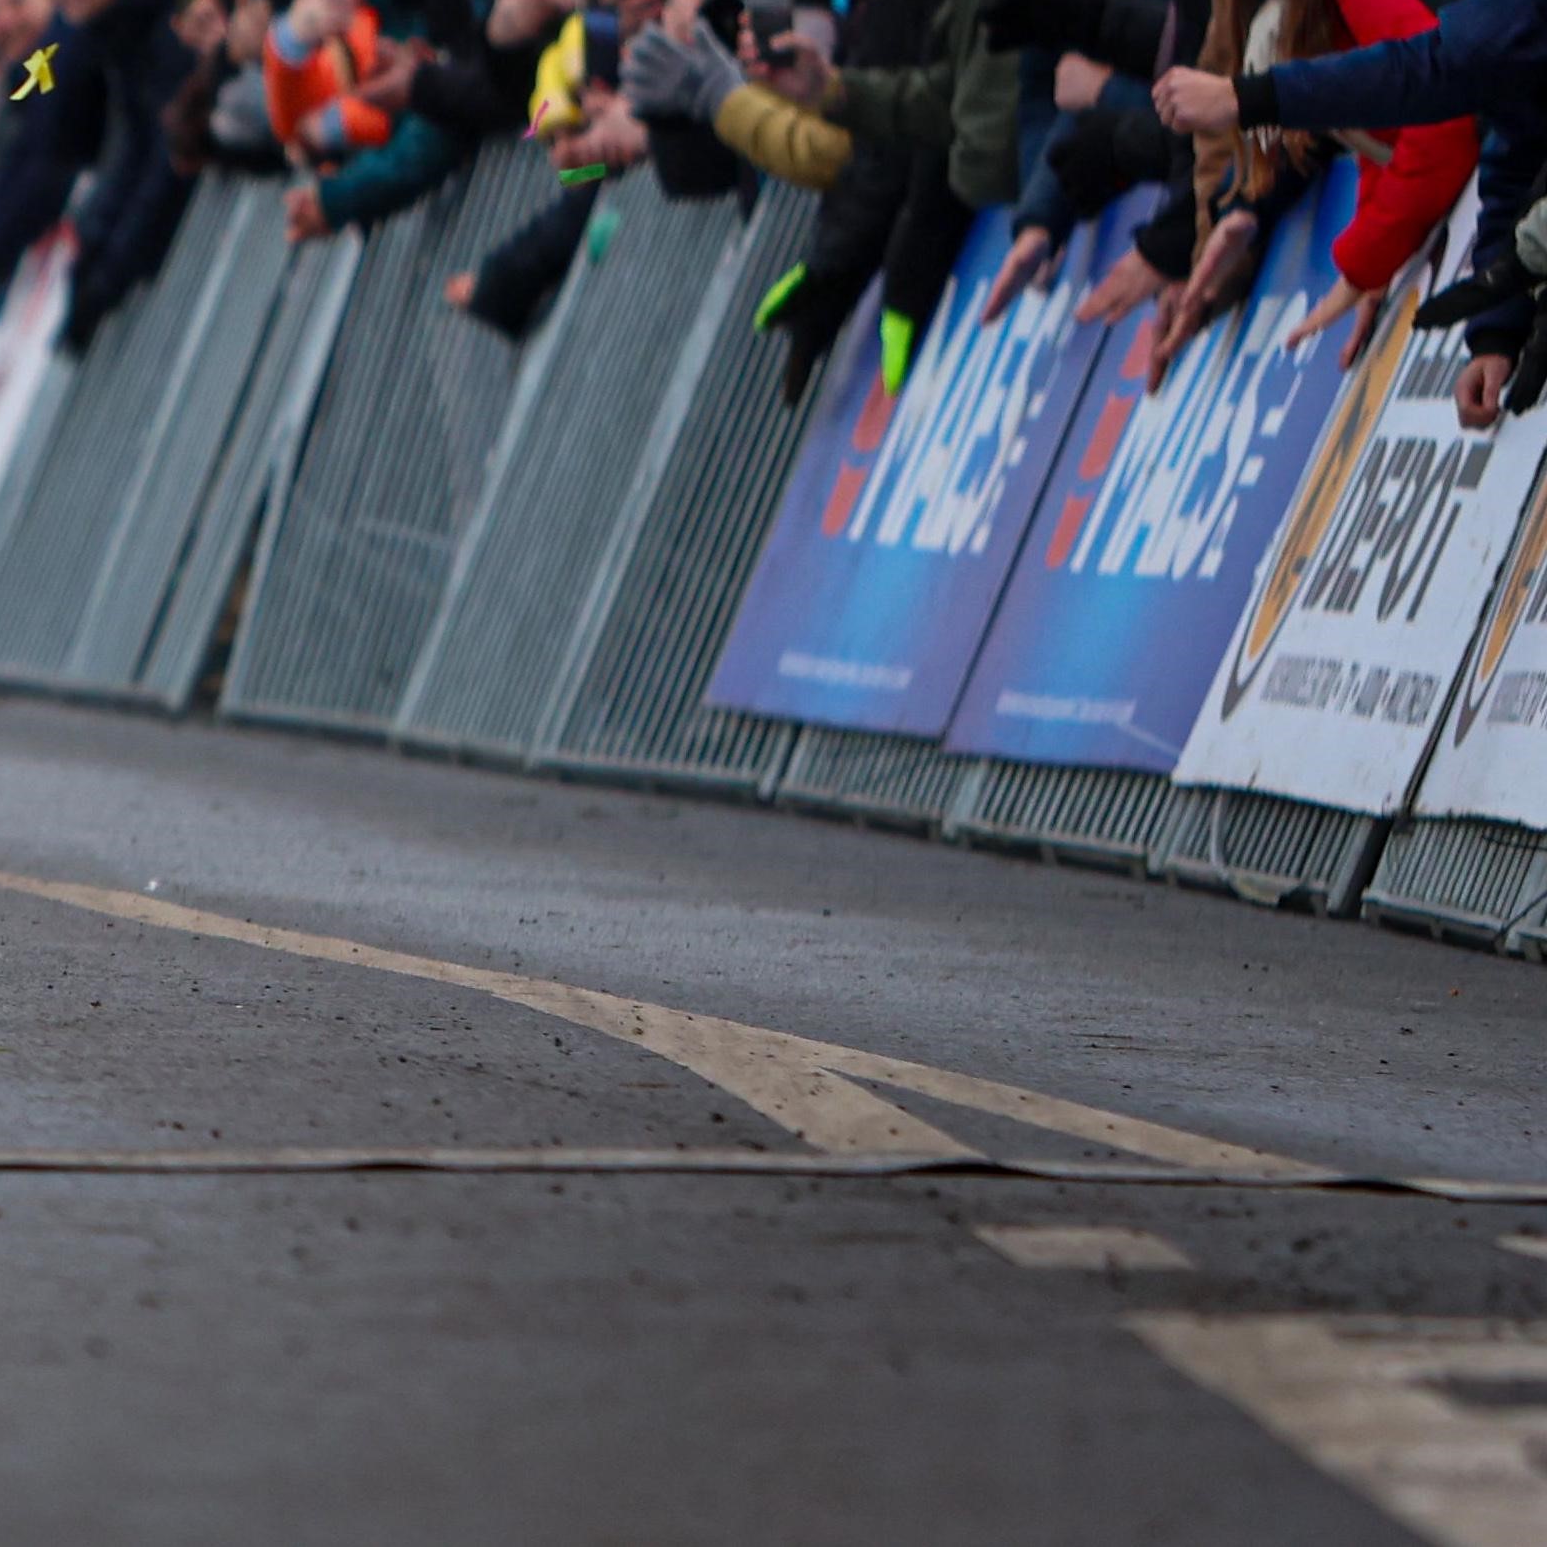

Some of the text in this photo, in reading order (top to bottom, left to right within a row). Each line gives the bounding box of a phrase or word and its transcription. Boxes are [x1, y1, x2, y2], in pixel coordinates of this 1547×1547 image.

[847, 274, 1071, 558] MAES
[1070, 290, 1311, 579] MAES
[1302, 437, 1495, 623] DEPOT
